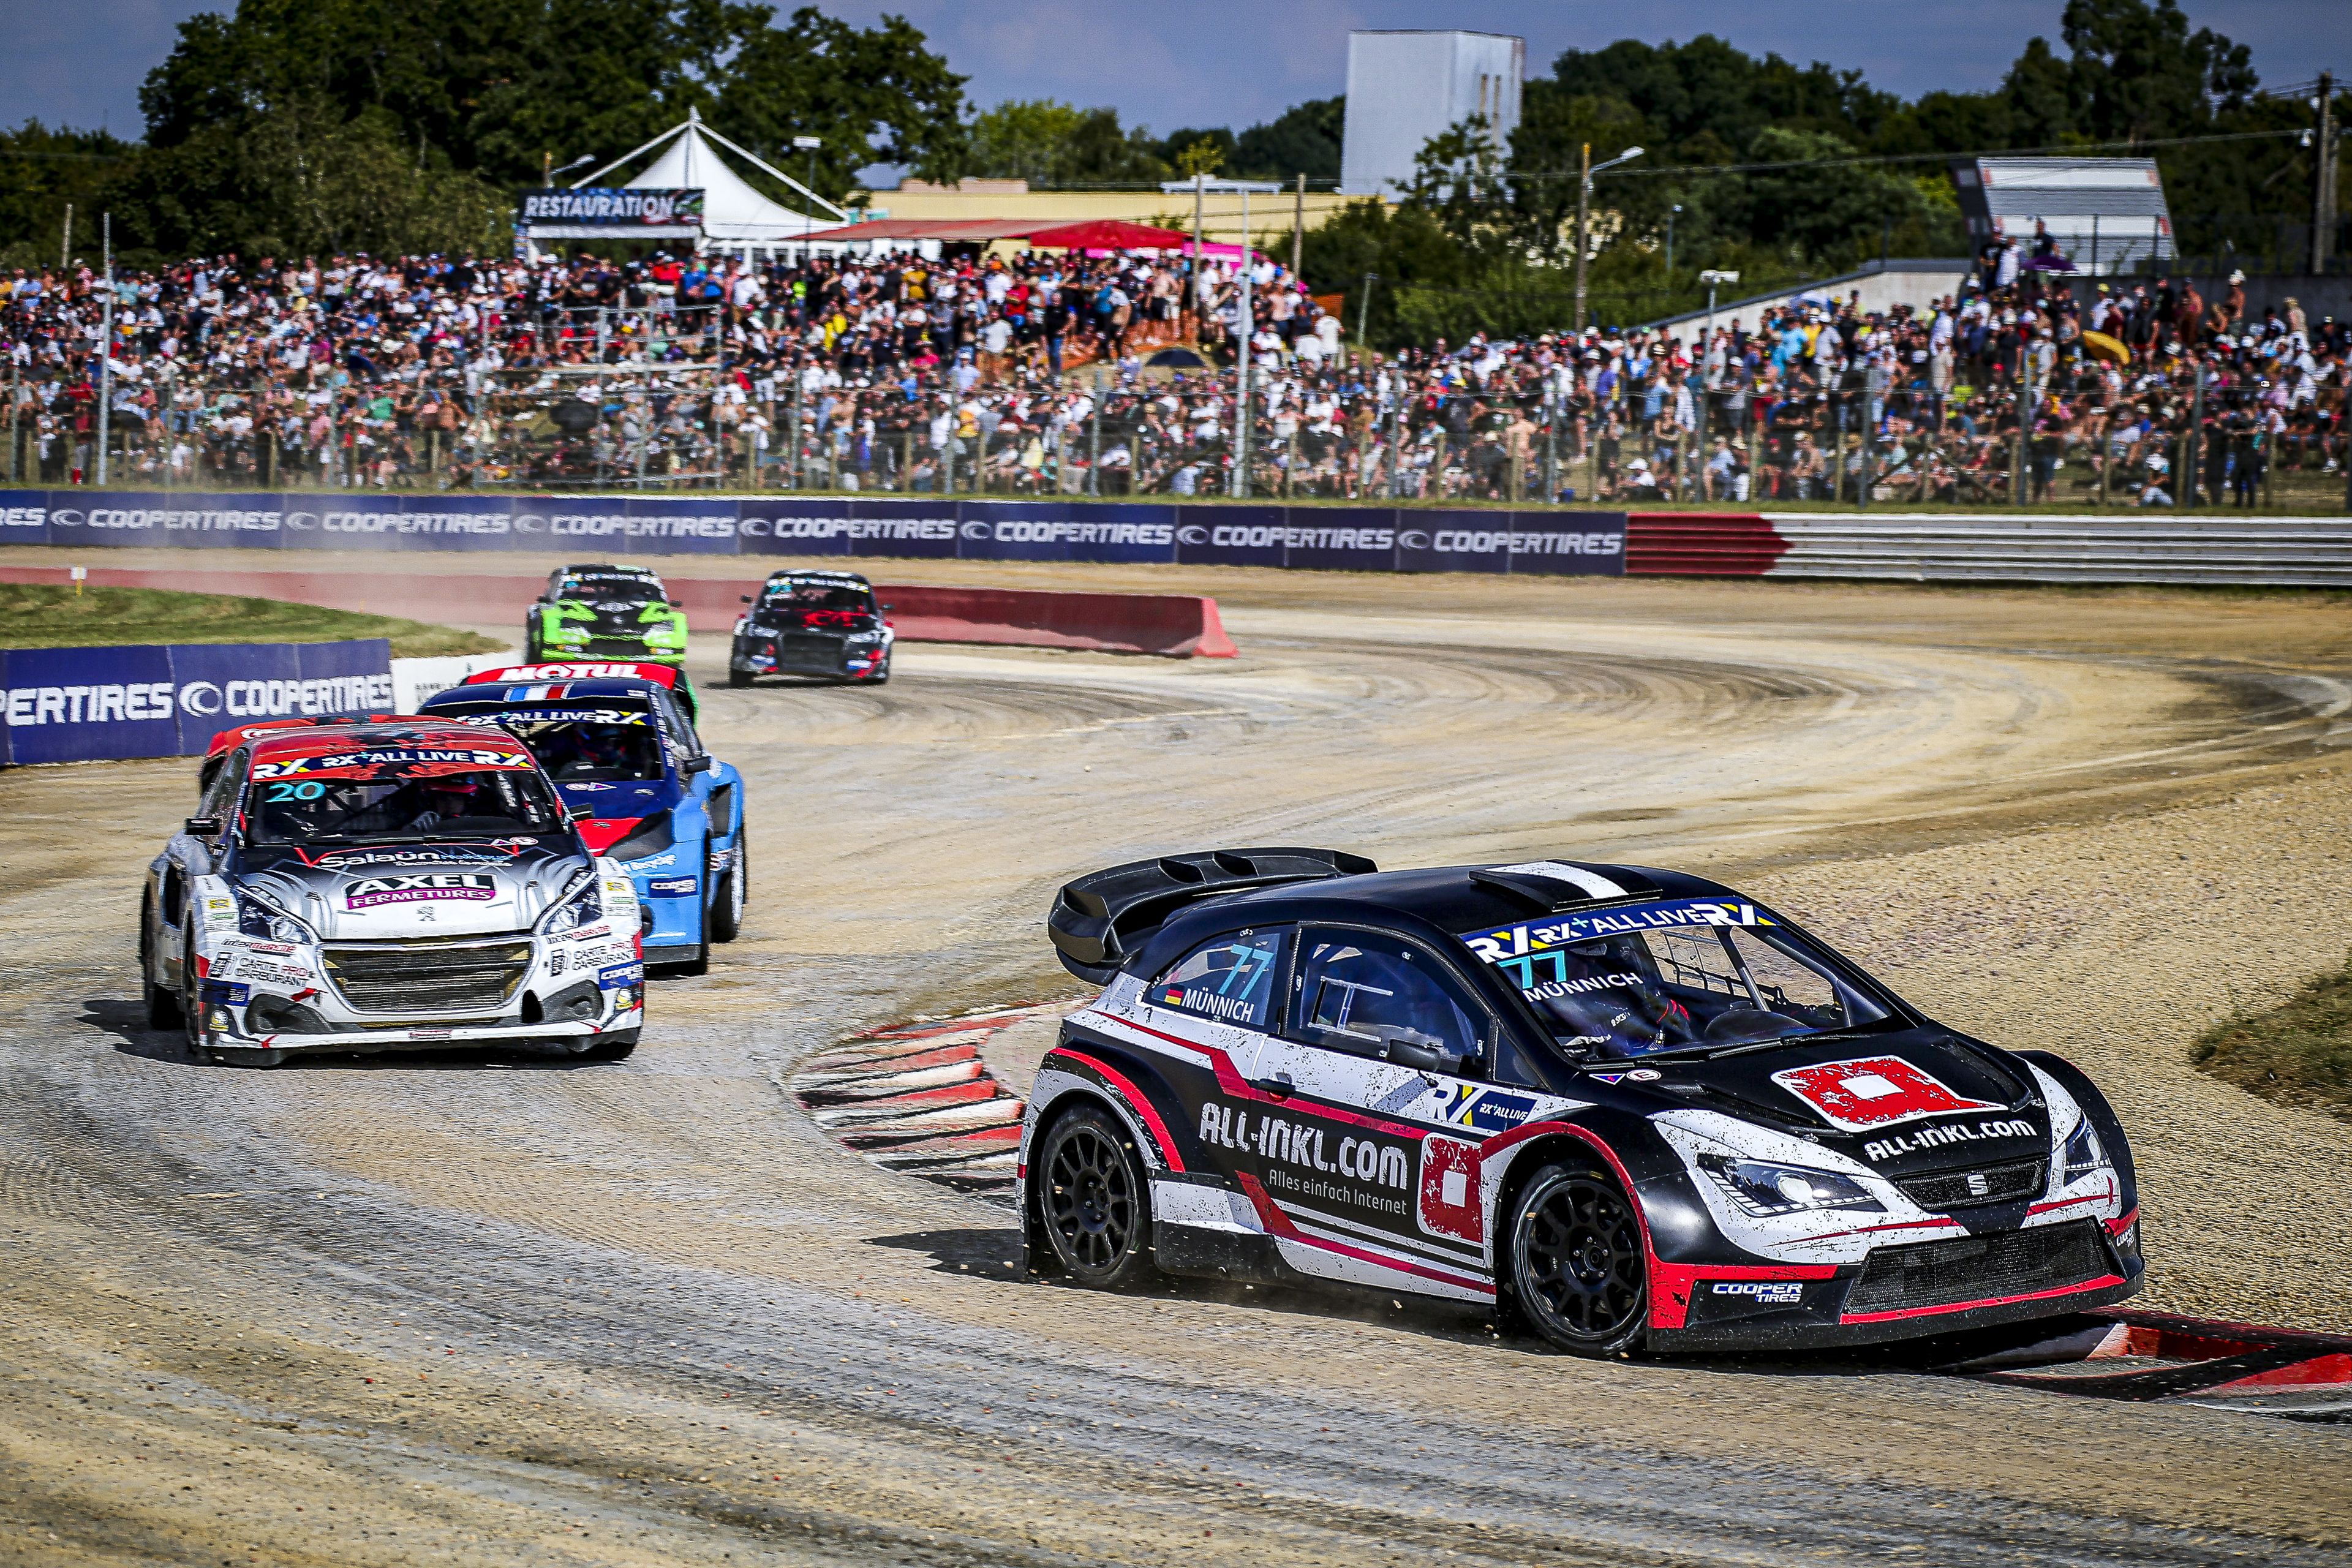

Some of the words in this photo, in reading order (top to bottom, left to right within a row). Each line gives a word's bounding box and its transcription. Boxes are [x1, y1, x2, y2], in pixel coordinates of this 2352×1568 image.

[524, 195, 674, 217] RESTAURATION
[88, 508, 281, 531] COOPERTIRES
[322, 512, 511, 533] COOPERTIRES
[551, 515, 734, 538] COOPERTIRES
[775, 518, 956, 540] COOPERTIRES
[995, 521, 1172, 545] COOPERTIRES
[1213, 526, 1395, 549] COOPERTIRES
[1434, 530, 1622, 555] COOPERTIRES
[497, 663, 642, 681] MOTUL
[0, 682, 173, 726] ERTIRES
[225, 673, 394, 717] COOPERTIRES
[594, 709, 648, 725] RX
[417, 751, 470, 762] LIVE
[472, 750, 535, 770] RX
[252, 757, 312, 779] RX
[265, 781, 326, 803] 20
[320, 851, 440, 868] Salaün
[351, 874, 491, 896] AXEL
[351, 889, 492, 908] FERMETURES
[1641, 909, 1707, 925] LIVE
[1689, 903, 1777, 926] RX
[1466, 925, 1552, 963] RX
[1218, 943, 1274, 1000] 77
[1495, 949, 1567, 989] 77
[1521, 971, 1644, 1003] MÜNNICH
[1181, 987, 1254, 1022] MÜNNICH
[1430, 1082, 1489, 1126] RX
[1509, 1109, 1529, 1121] LIVE
[1269, 1169, 1300, 1191] Alles
[1303, 1178, 1351, 1204] einfach
[1354, 1189, 1407, 1215] Internet
[1712, 1283, 1803, 1295] COOPER
[1755, 1294, 1801, 1303] TIRES
